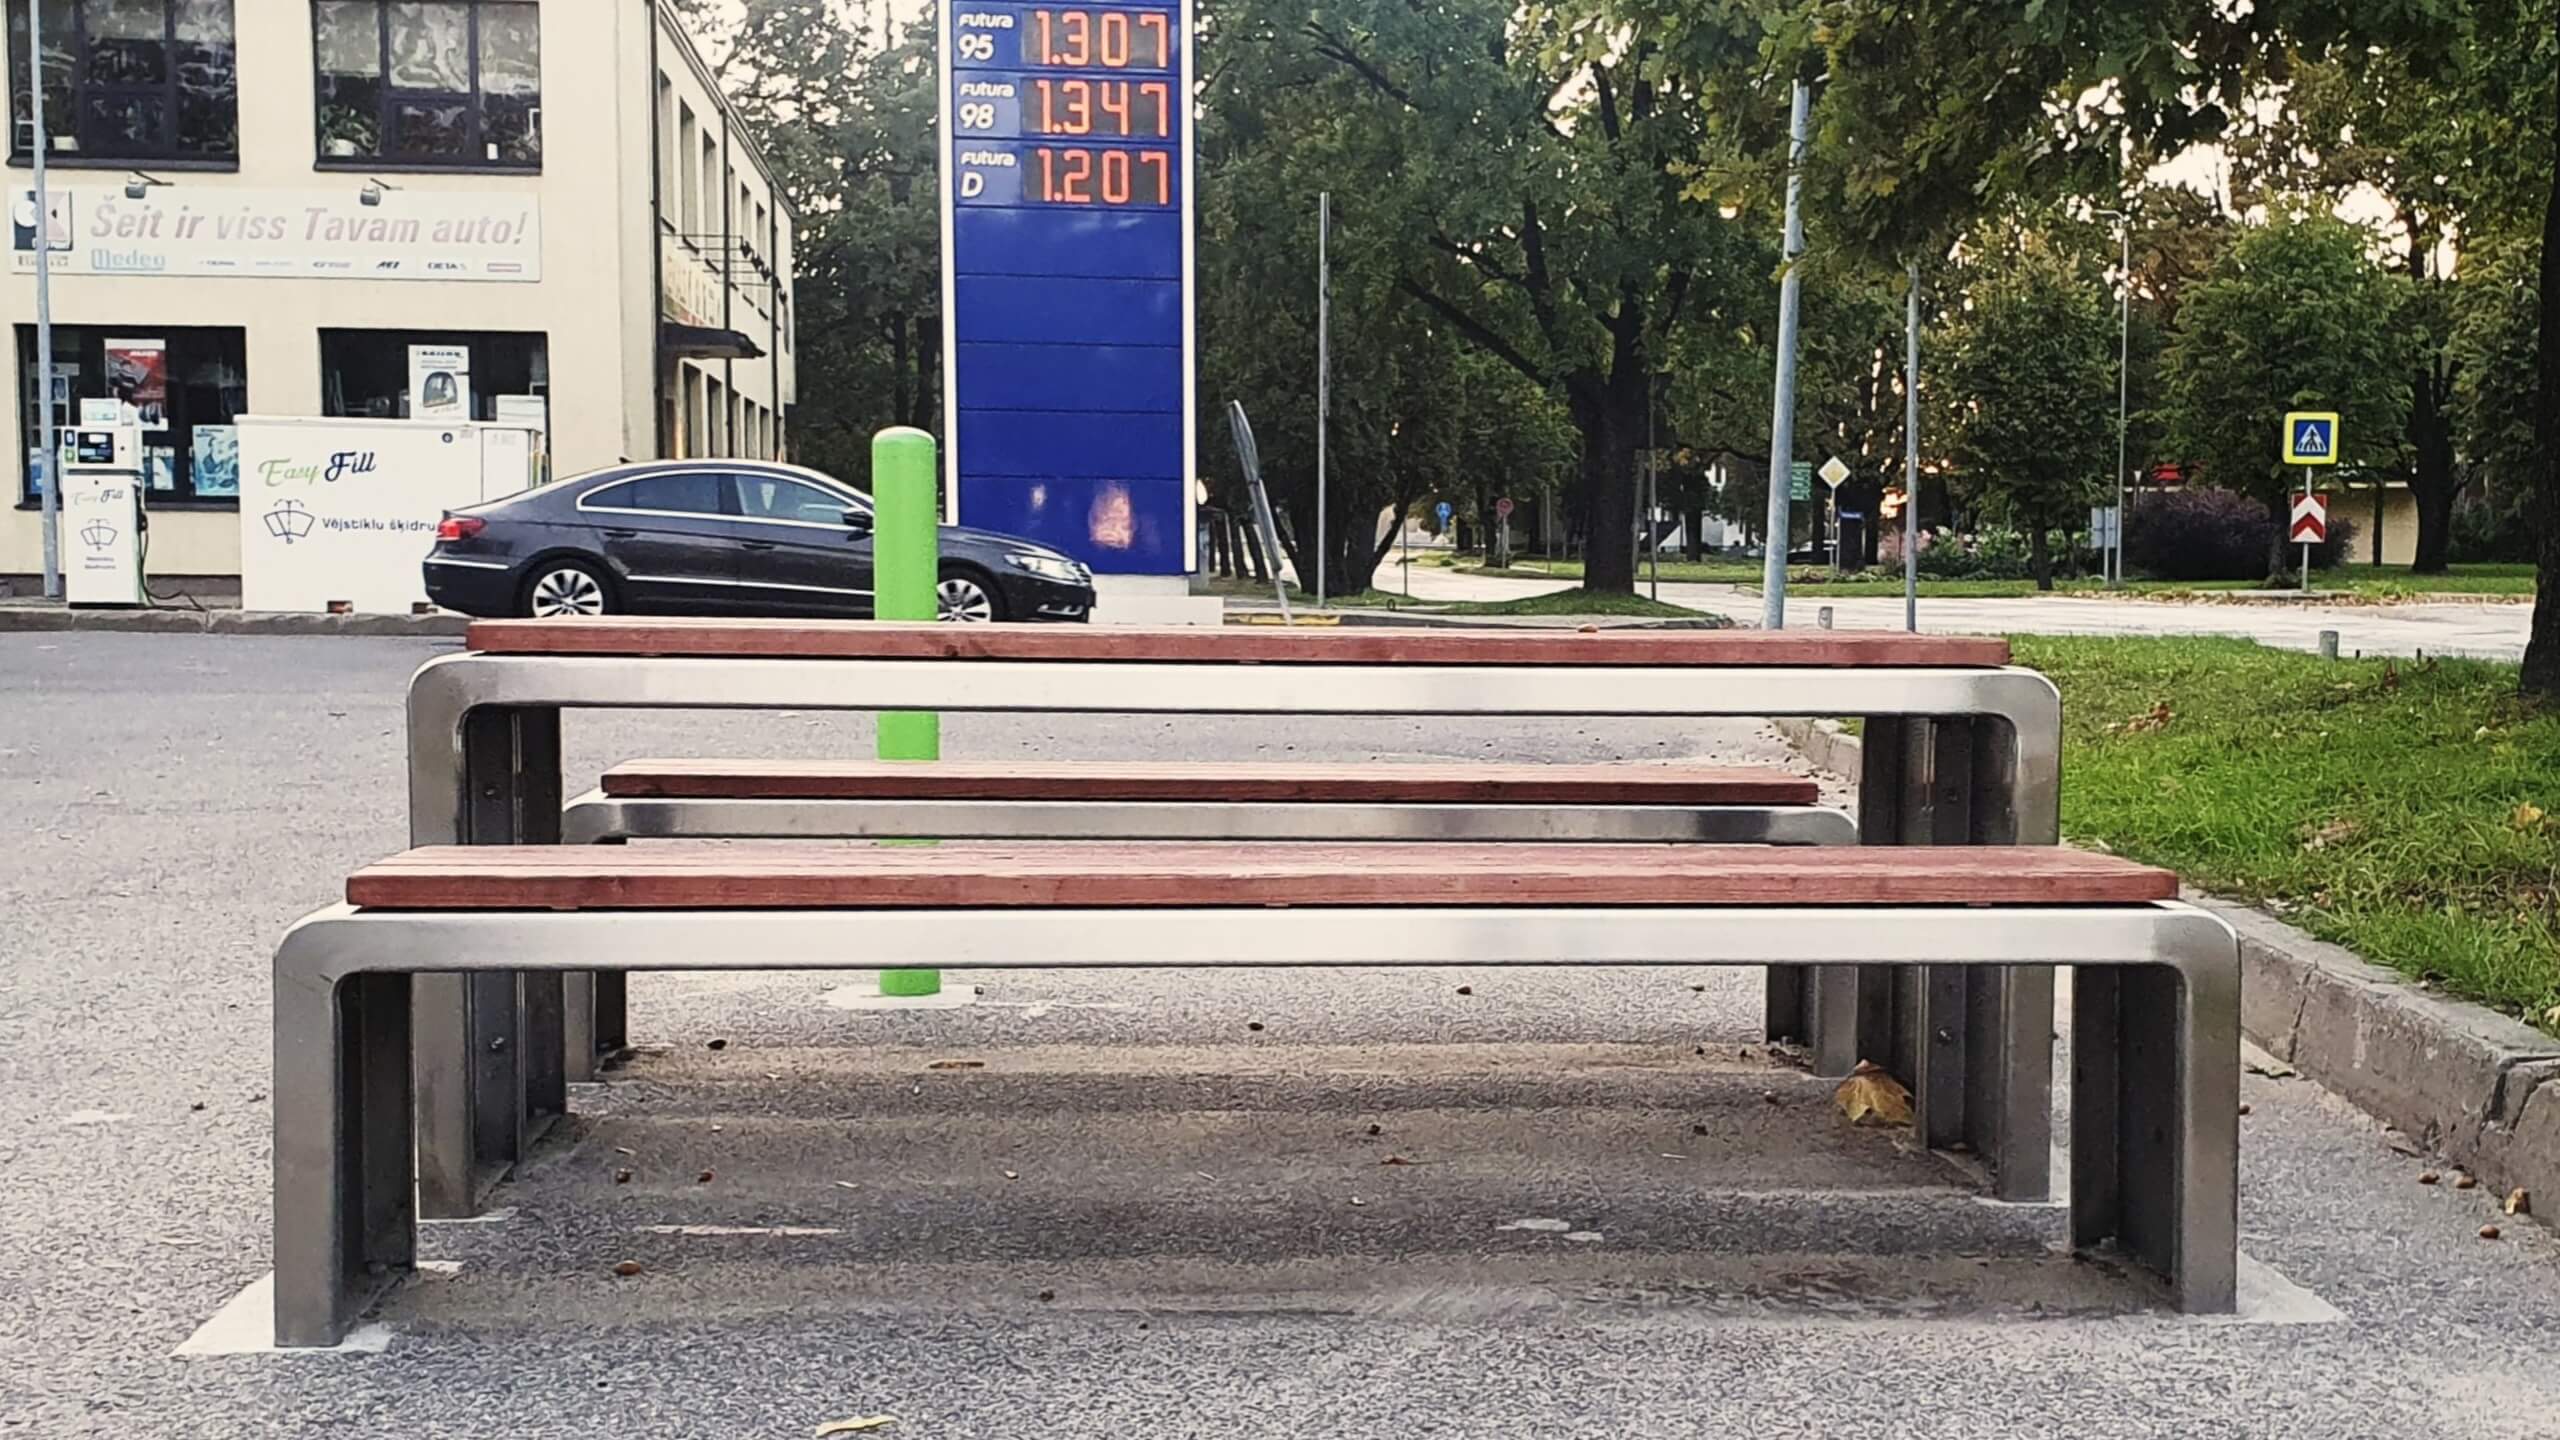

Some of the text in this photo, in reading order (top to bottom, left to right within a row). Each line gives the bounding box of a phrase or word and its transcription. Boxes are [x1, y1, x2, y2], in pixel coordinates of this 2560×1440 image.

[958, 33, 995, 61] 95
[1034, 10, 1169, 68] 1.307
[958, 103, 996, 130] 98
[1035, 78, 1169, 137] 1.347
[960, 171, 984, 198] D
[1036, 147, 1169, 206] 1.207
[90, 194, 529, 245] Šeit ir viss Tavam auto!
[257, 451, 377, 488] Easy Fill
[389, 517, 437, 534] šķidru
